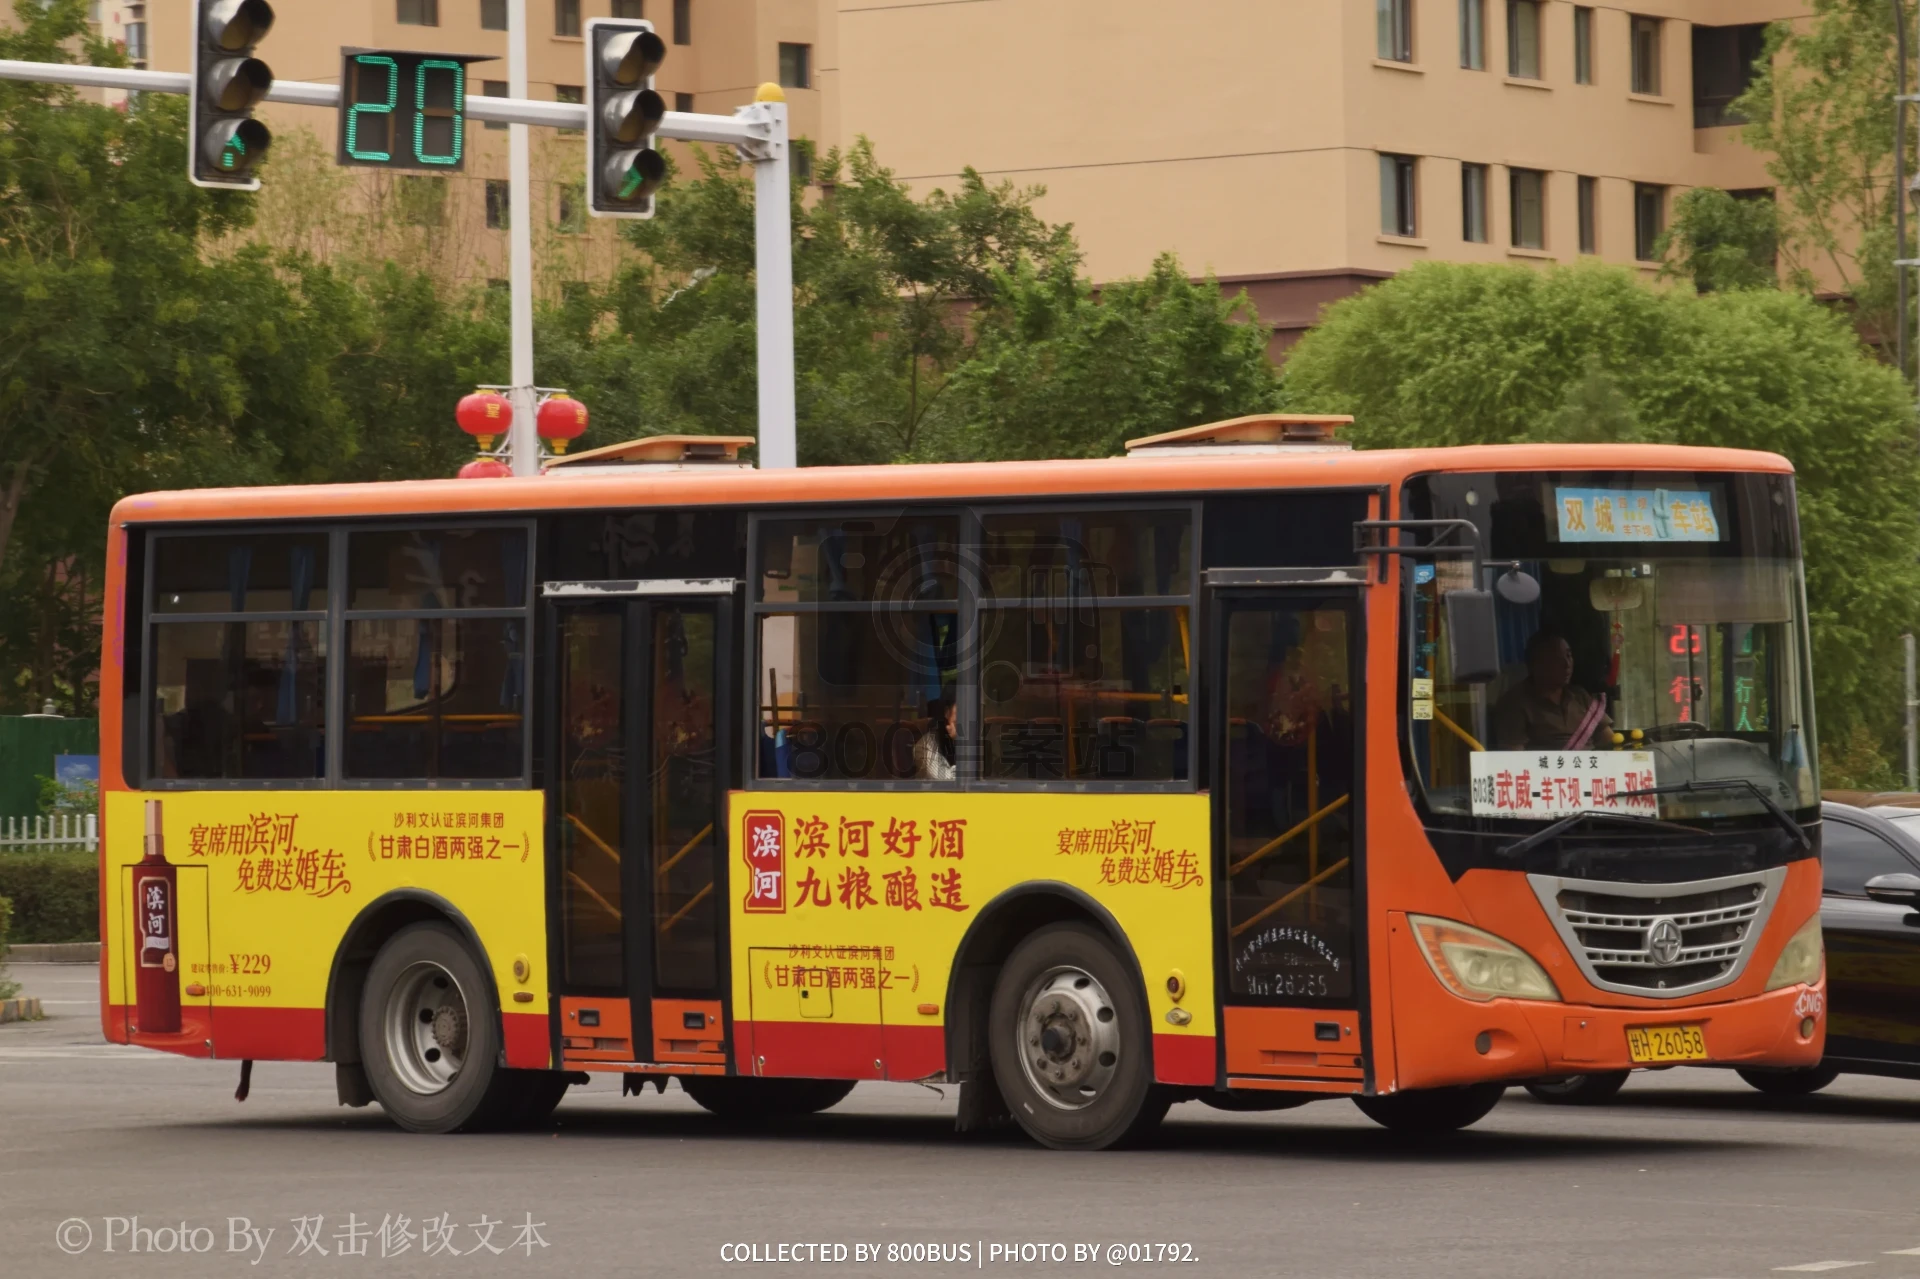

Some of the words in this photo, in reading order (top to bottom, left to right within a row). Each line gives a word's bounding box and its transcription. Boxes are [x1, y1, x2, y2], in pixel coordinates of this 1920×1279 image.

[346, 54, 463, 164] 20
[1564, 497, 1614, 533] 双城
[1735, 677, 1754, 732] 行人
[1539, 755, 1598, 769] 城乡公交
[394, 812, 504, 829] 沙利文认证滨河集团
[793, 814, 968, 861] 滨河好酒
[379, 834, 520, 860] 甘肃白酒两强之一
[753, 824, 781, 900] 滨河
[232, 848, 351, 898] 免费送婚车
[1096, 848, 1204, 890] 免费送婚车
[793, 865, 970, 913] 九粮酿造
[146, 886, 165, 935] 滨河
[229, 954, 271, 975] ¥229
[788, 943, 895, 961] 沙利文认证滨河集团
[775, 964, 910, 990] 甘肃白酒两强之一
[1799, 993, 1821, 1013] CNG
